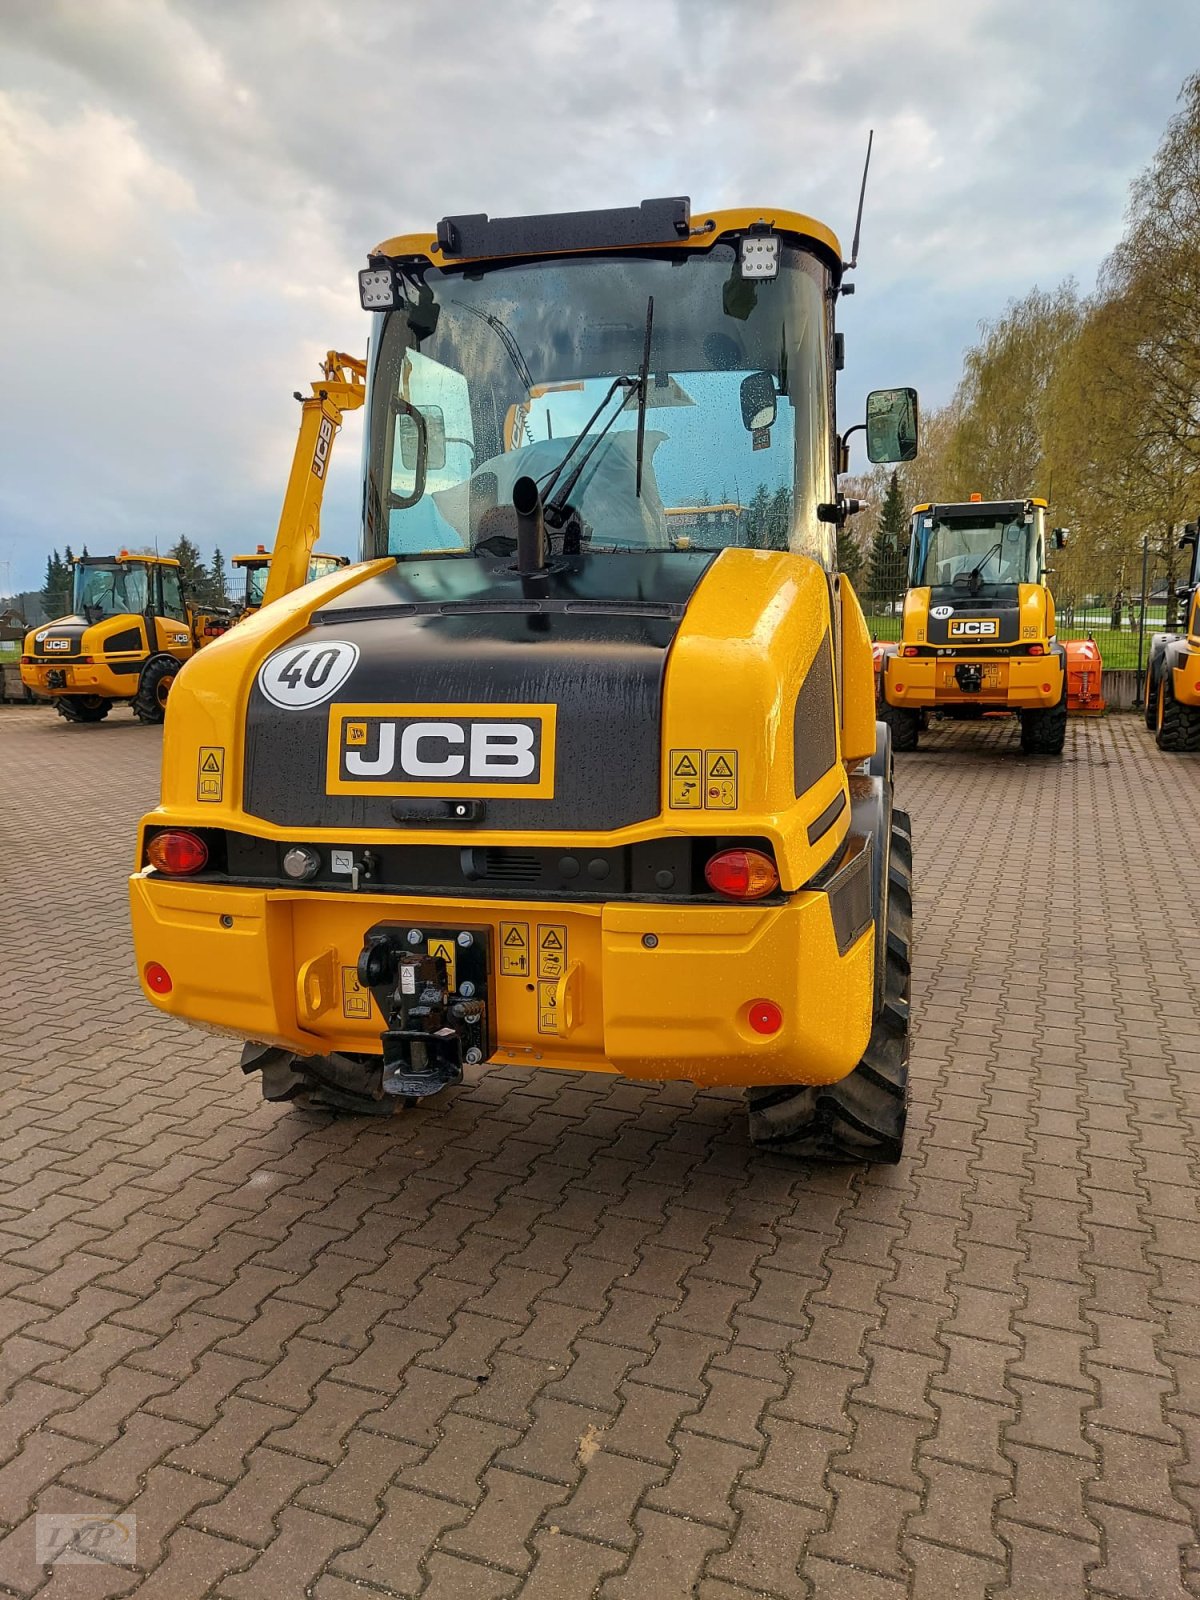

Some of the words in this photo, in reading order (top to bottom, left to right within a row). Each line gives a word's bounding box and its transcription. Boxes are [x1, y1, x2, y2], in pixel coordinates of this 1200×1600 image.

[314, 418, 333, 478] JCB
[935, 607, 949, 615] 40
[952, 622, 995, 634] JCB
[173, 634, 188, 642] JCB
[46, 641, 68, 649] JCB
[277, 648, 341, 689] 40
[345, 722, 535, 778] JCB
